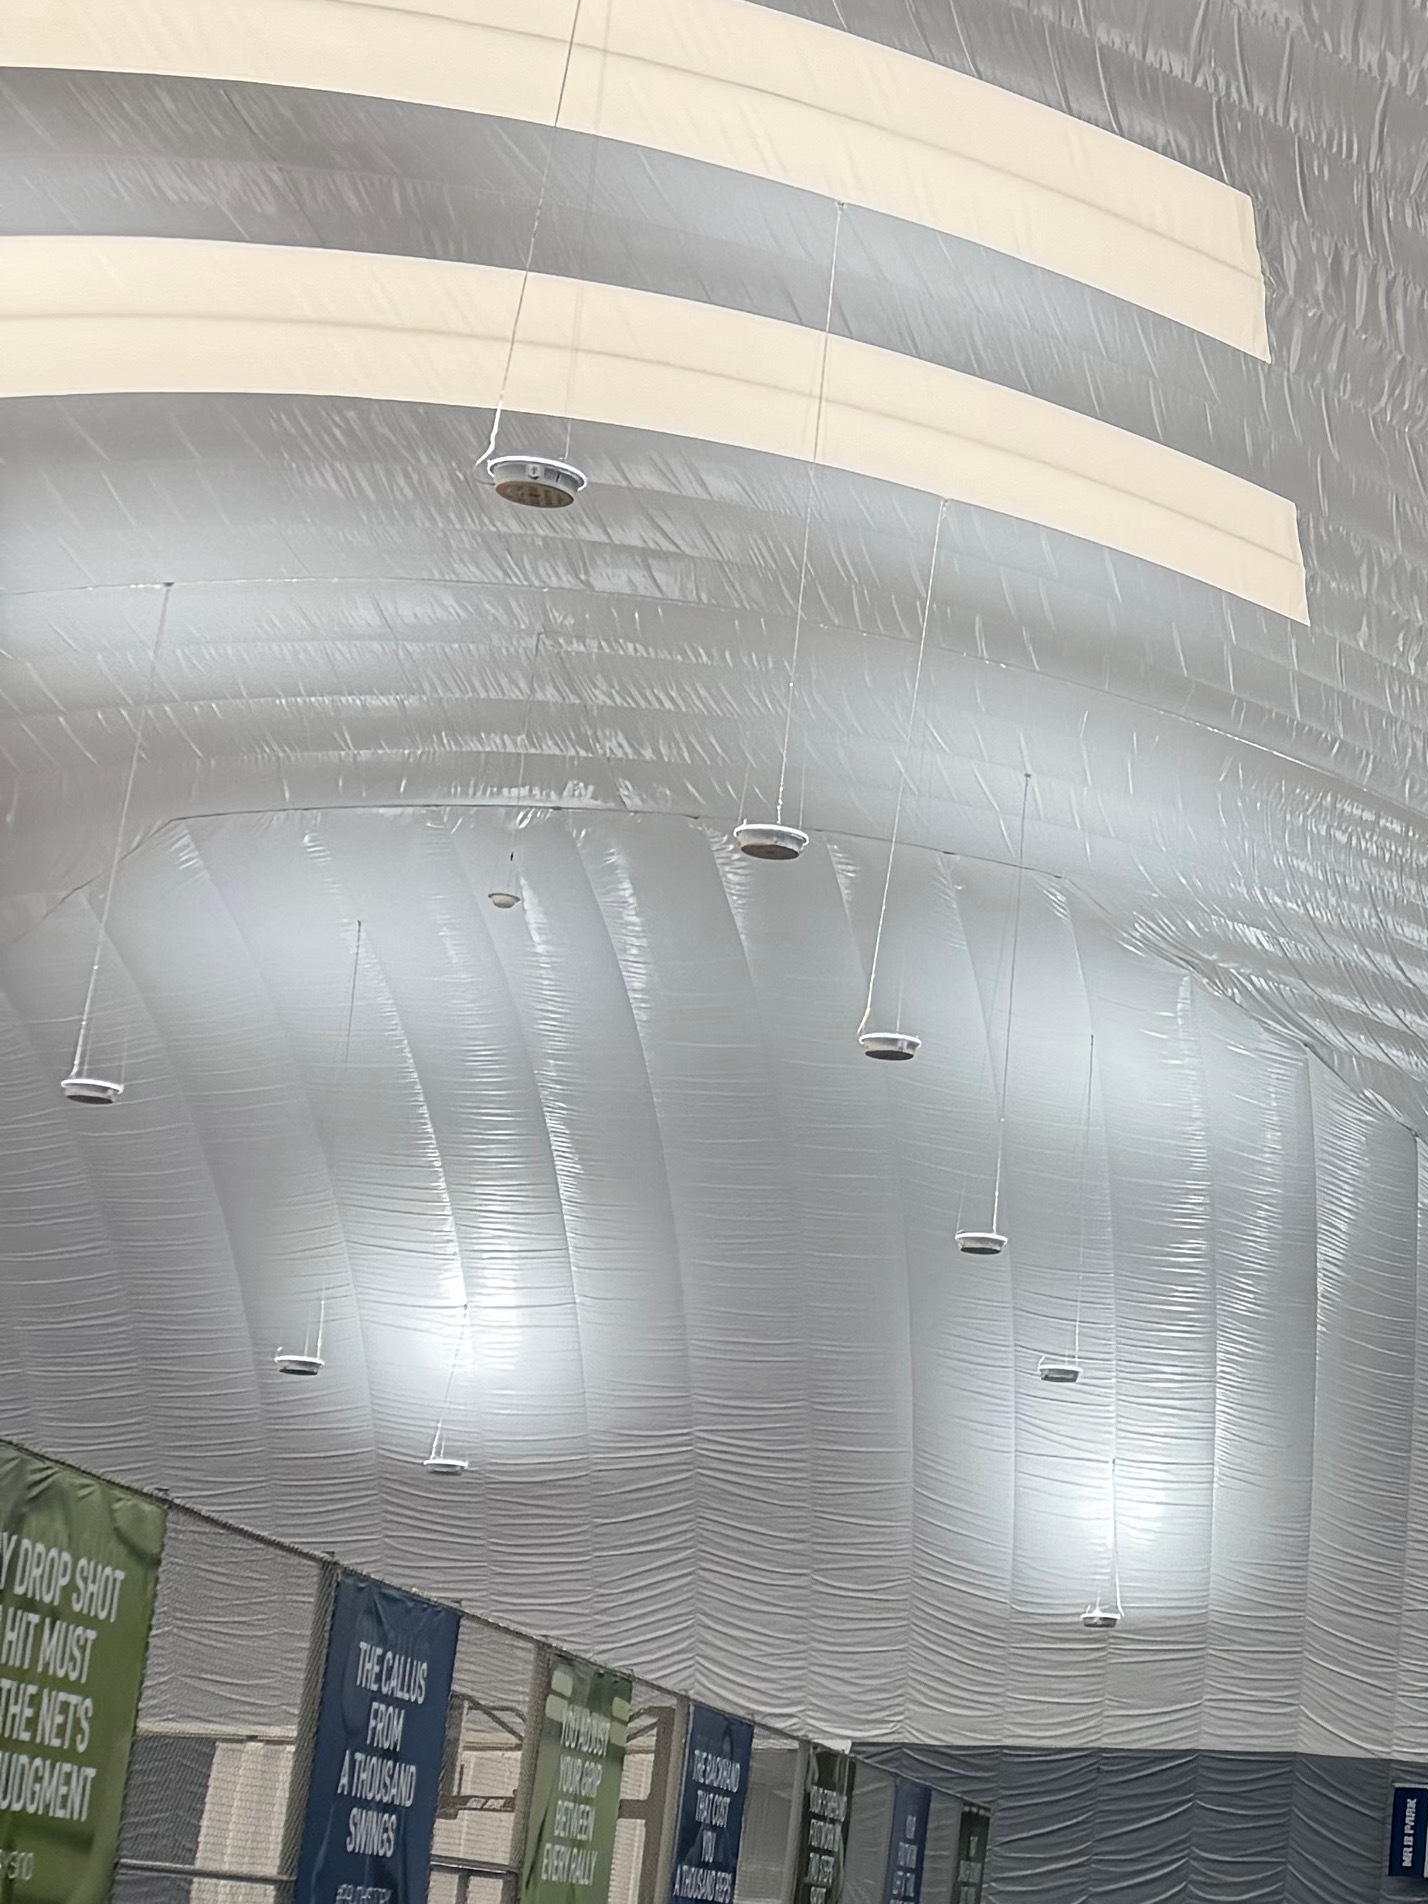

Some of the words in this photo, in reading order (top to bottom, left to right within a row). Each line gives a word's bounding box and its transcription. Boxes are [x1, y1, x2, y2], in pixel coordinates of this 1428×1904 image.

[13, 1538, 72, 1606] DROP
[71, 1557, 125, 1623] SHOT
[1, 1607, 40, 1669] HIT
[37, 1617, 97, 1684] MUST
[356, 1641, 383, 1692] THE
[381, 1650, 428, 1705] CALLUS
[0, 1678, 38, 1741] THE
[366, 1701, 405, 1752] FROM
[0, 1751, 97, 1822] UDGMENT
[337, 1749, 350, 1794] A
[352, 1752, 416, 1807] THOUSAND
[558, 1755, 582, 1794] YOUR
[346, 1807, 397, 1858] SWINGS
[554, 1799, 596, 1842] BETWEEN
[1404, 1798, 1417, 1834] PARK
[541, 1842, 572, 1884] EVERY
[568, 1847, 598, 1886] RALLY
